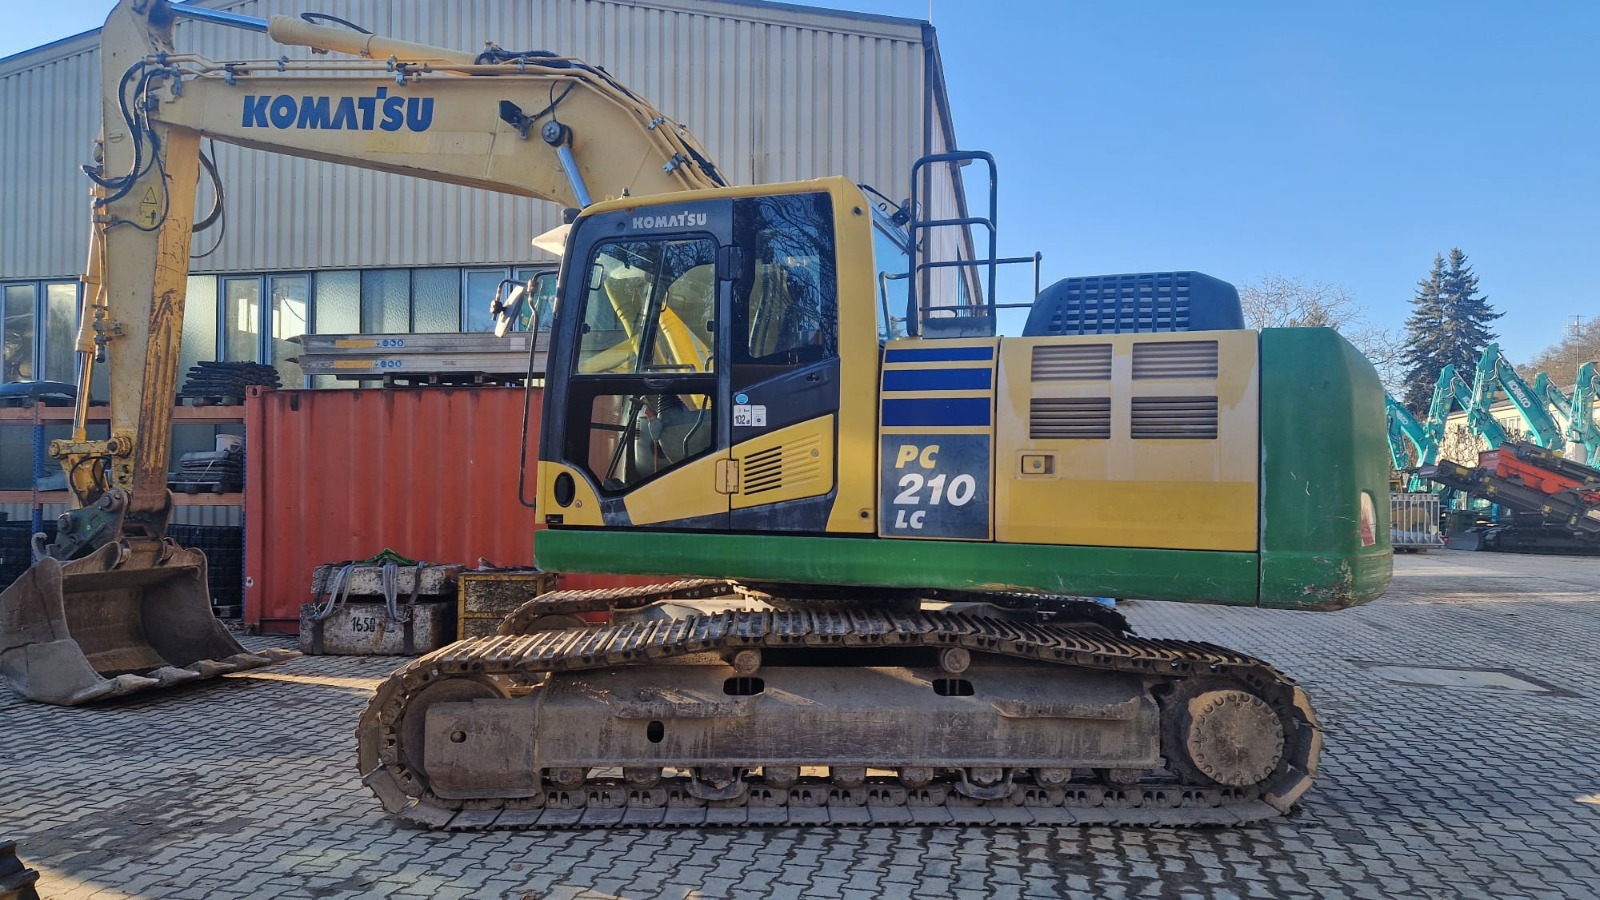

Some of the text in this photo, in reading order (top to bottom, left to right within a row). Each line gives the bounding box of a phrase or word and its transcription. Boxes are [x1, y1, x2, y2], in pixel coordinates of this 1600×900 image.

[242, 87, 434, 132] KOMATSU
[632, 210, 707, 229] KOMATSU
[1507, 380, 1531, 408] KOBELCO
[735, 414, 746, 425] 102
[895, 444, 940, 469] PC
[893, 473, 976, 506] 210
[894, 510, 926, 529] LC
